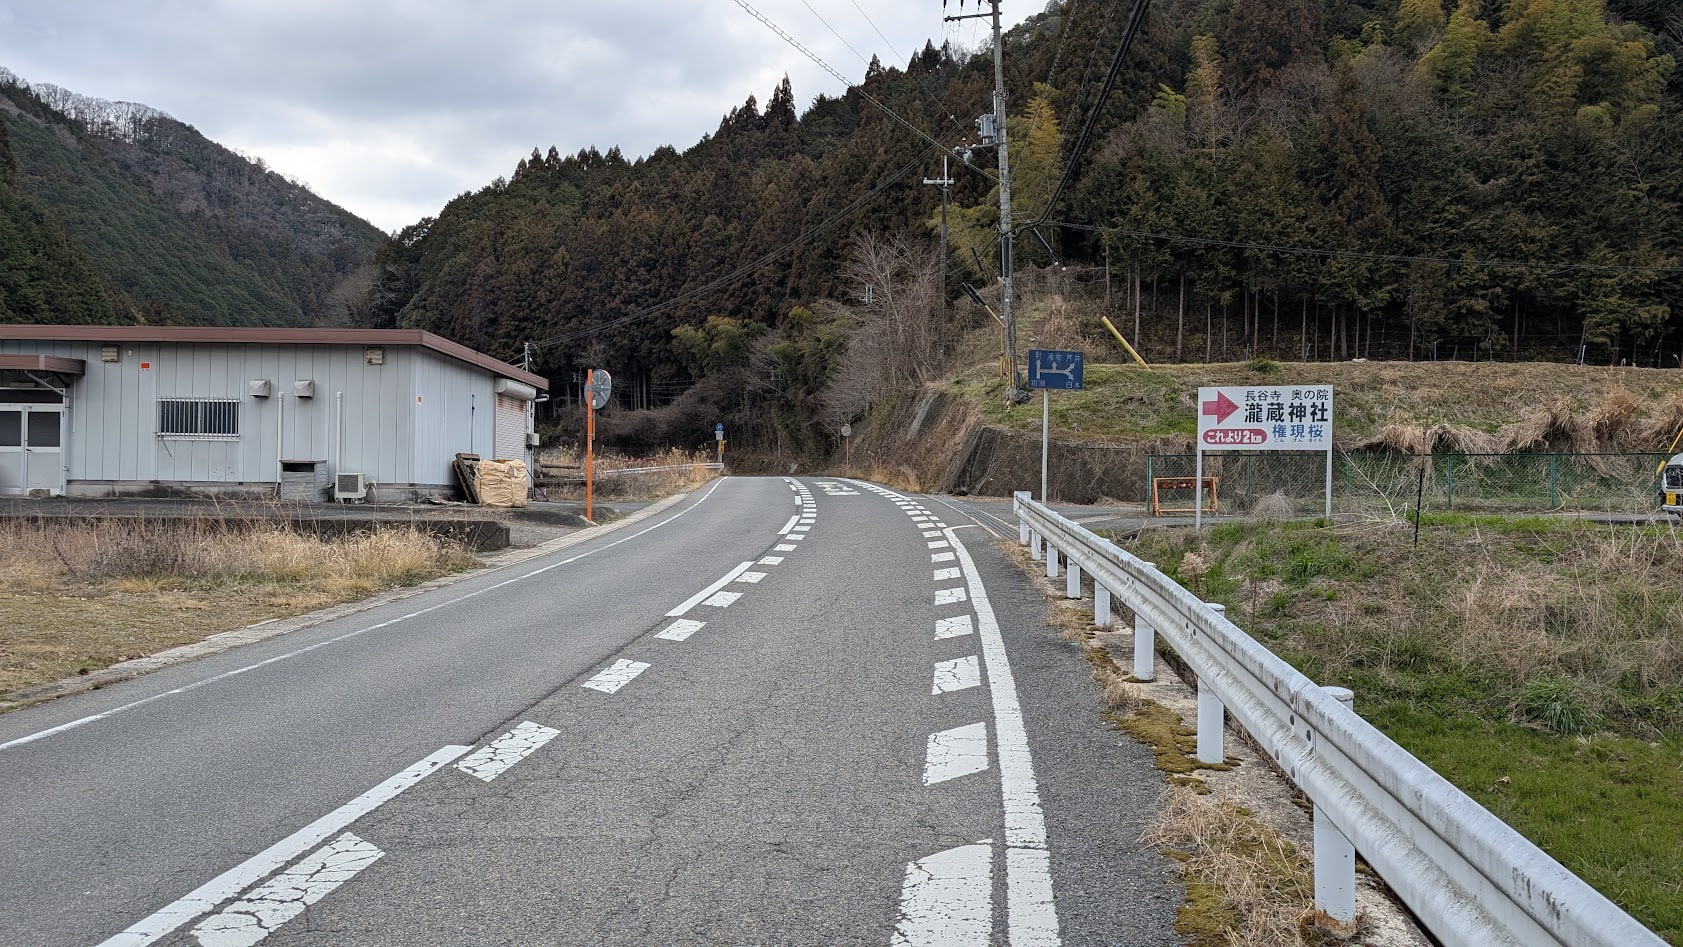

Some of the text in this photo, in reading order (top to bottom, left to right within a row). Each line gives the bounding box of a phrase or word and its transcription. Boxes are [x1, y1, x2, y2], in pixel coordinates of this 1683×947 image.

[1245, 389, 1329, 401] 長谷寺 奥の院
[1245, 401, 1329, 423] 瀧蔵神社
[1207, 430, 1262, 443] これより2km
[1272, 424, 1323, 438] 権現桜
